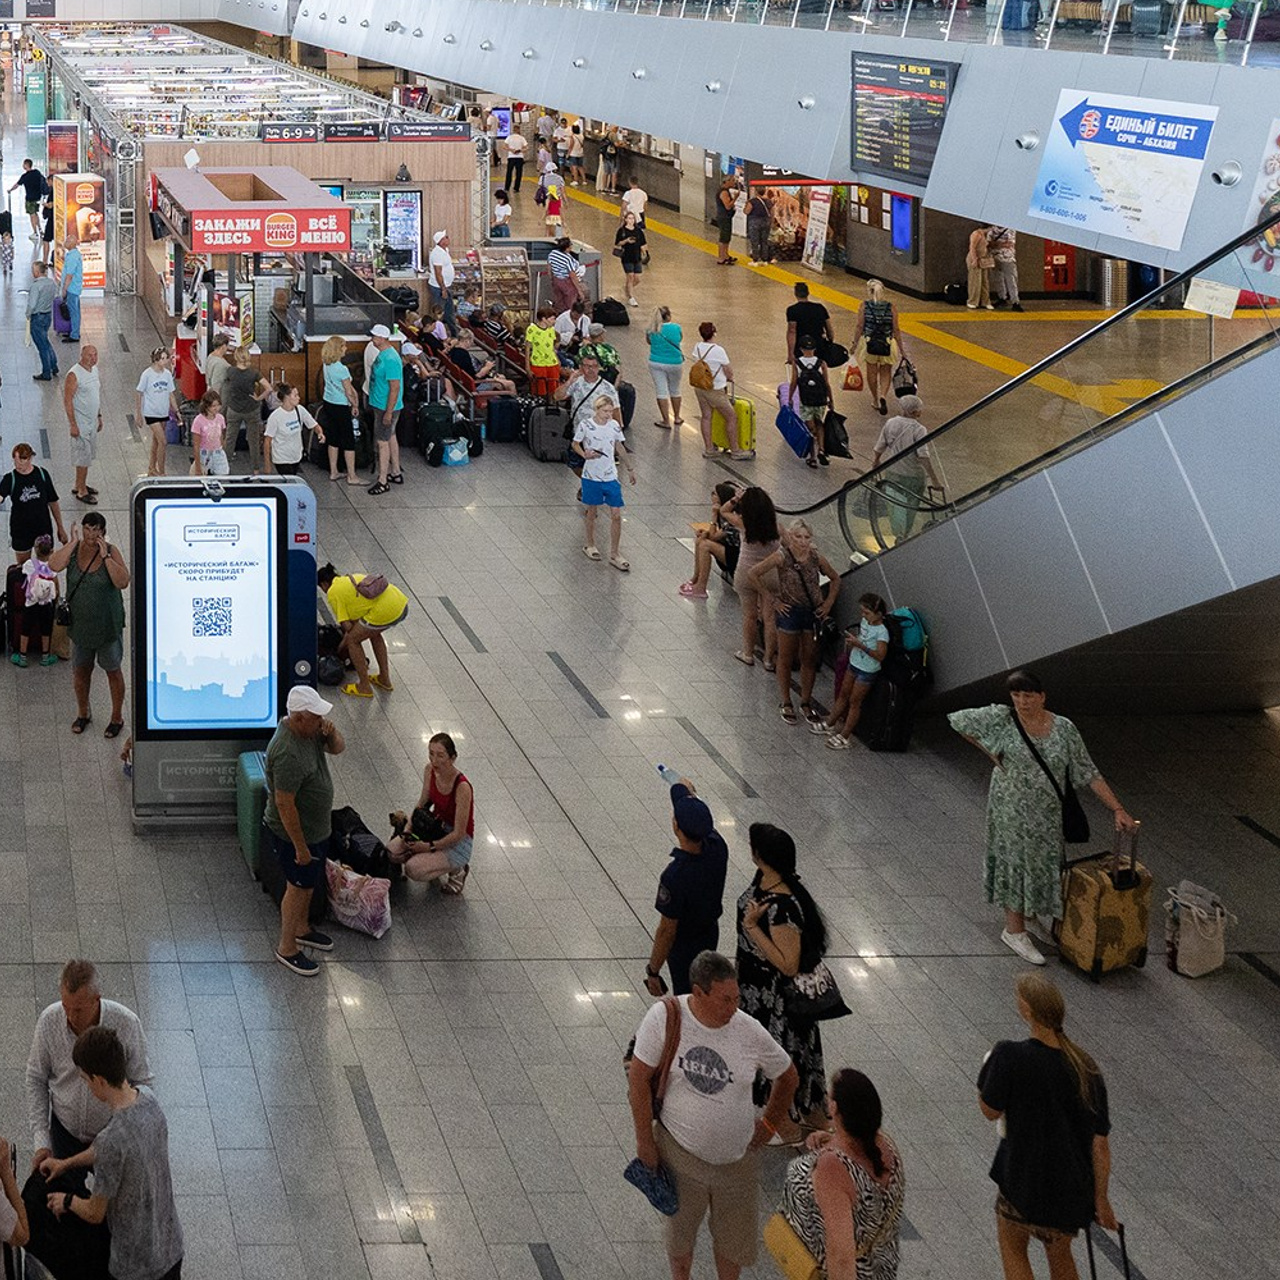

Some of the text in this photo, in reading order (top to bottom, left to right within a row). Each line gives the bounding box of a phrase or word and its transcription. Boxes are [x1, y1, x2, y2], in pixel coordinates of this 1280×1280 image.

[282, 128, 303, 139] 6-9
[1105, 114, 1199, 141] ЕДИНЫЙ БИЛЕТ
[1116, 133, 1138, 145] СОЧИ
[1142, 138, 1178, 151] АБХАЗИЯ
[194, 218, 261, 231] ЗАКАЖИ
[266, 223, 295, 231] BURGER
[308, 214, 338, 230] ВСЁ
[204, 232, 252, 245] ЗДЕСЬ
[266, 231, 295, 240] KING
[300, 232, 346, 244] МЕНЮ
[166, 766, 236, 776] ИСТОРИЧЕС
[678, 1056, 734, 1084] RELAX
